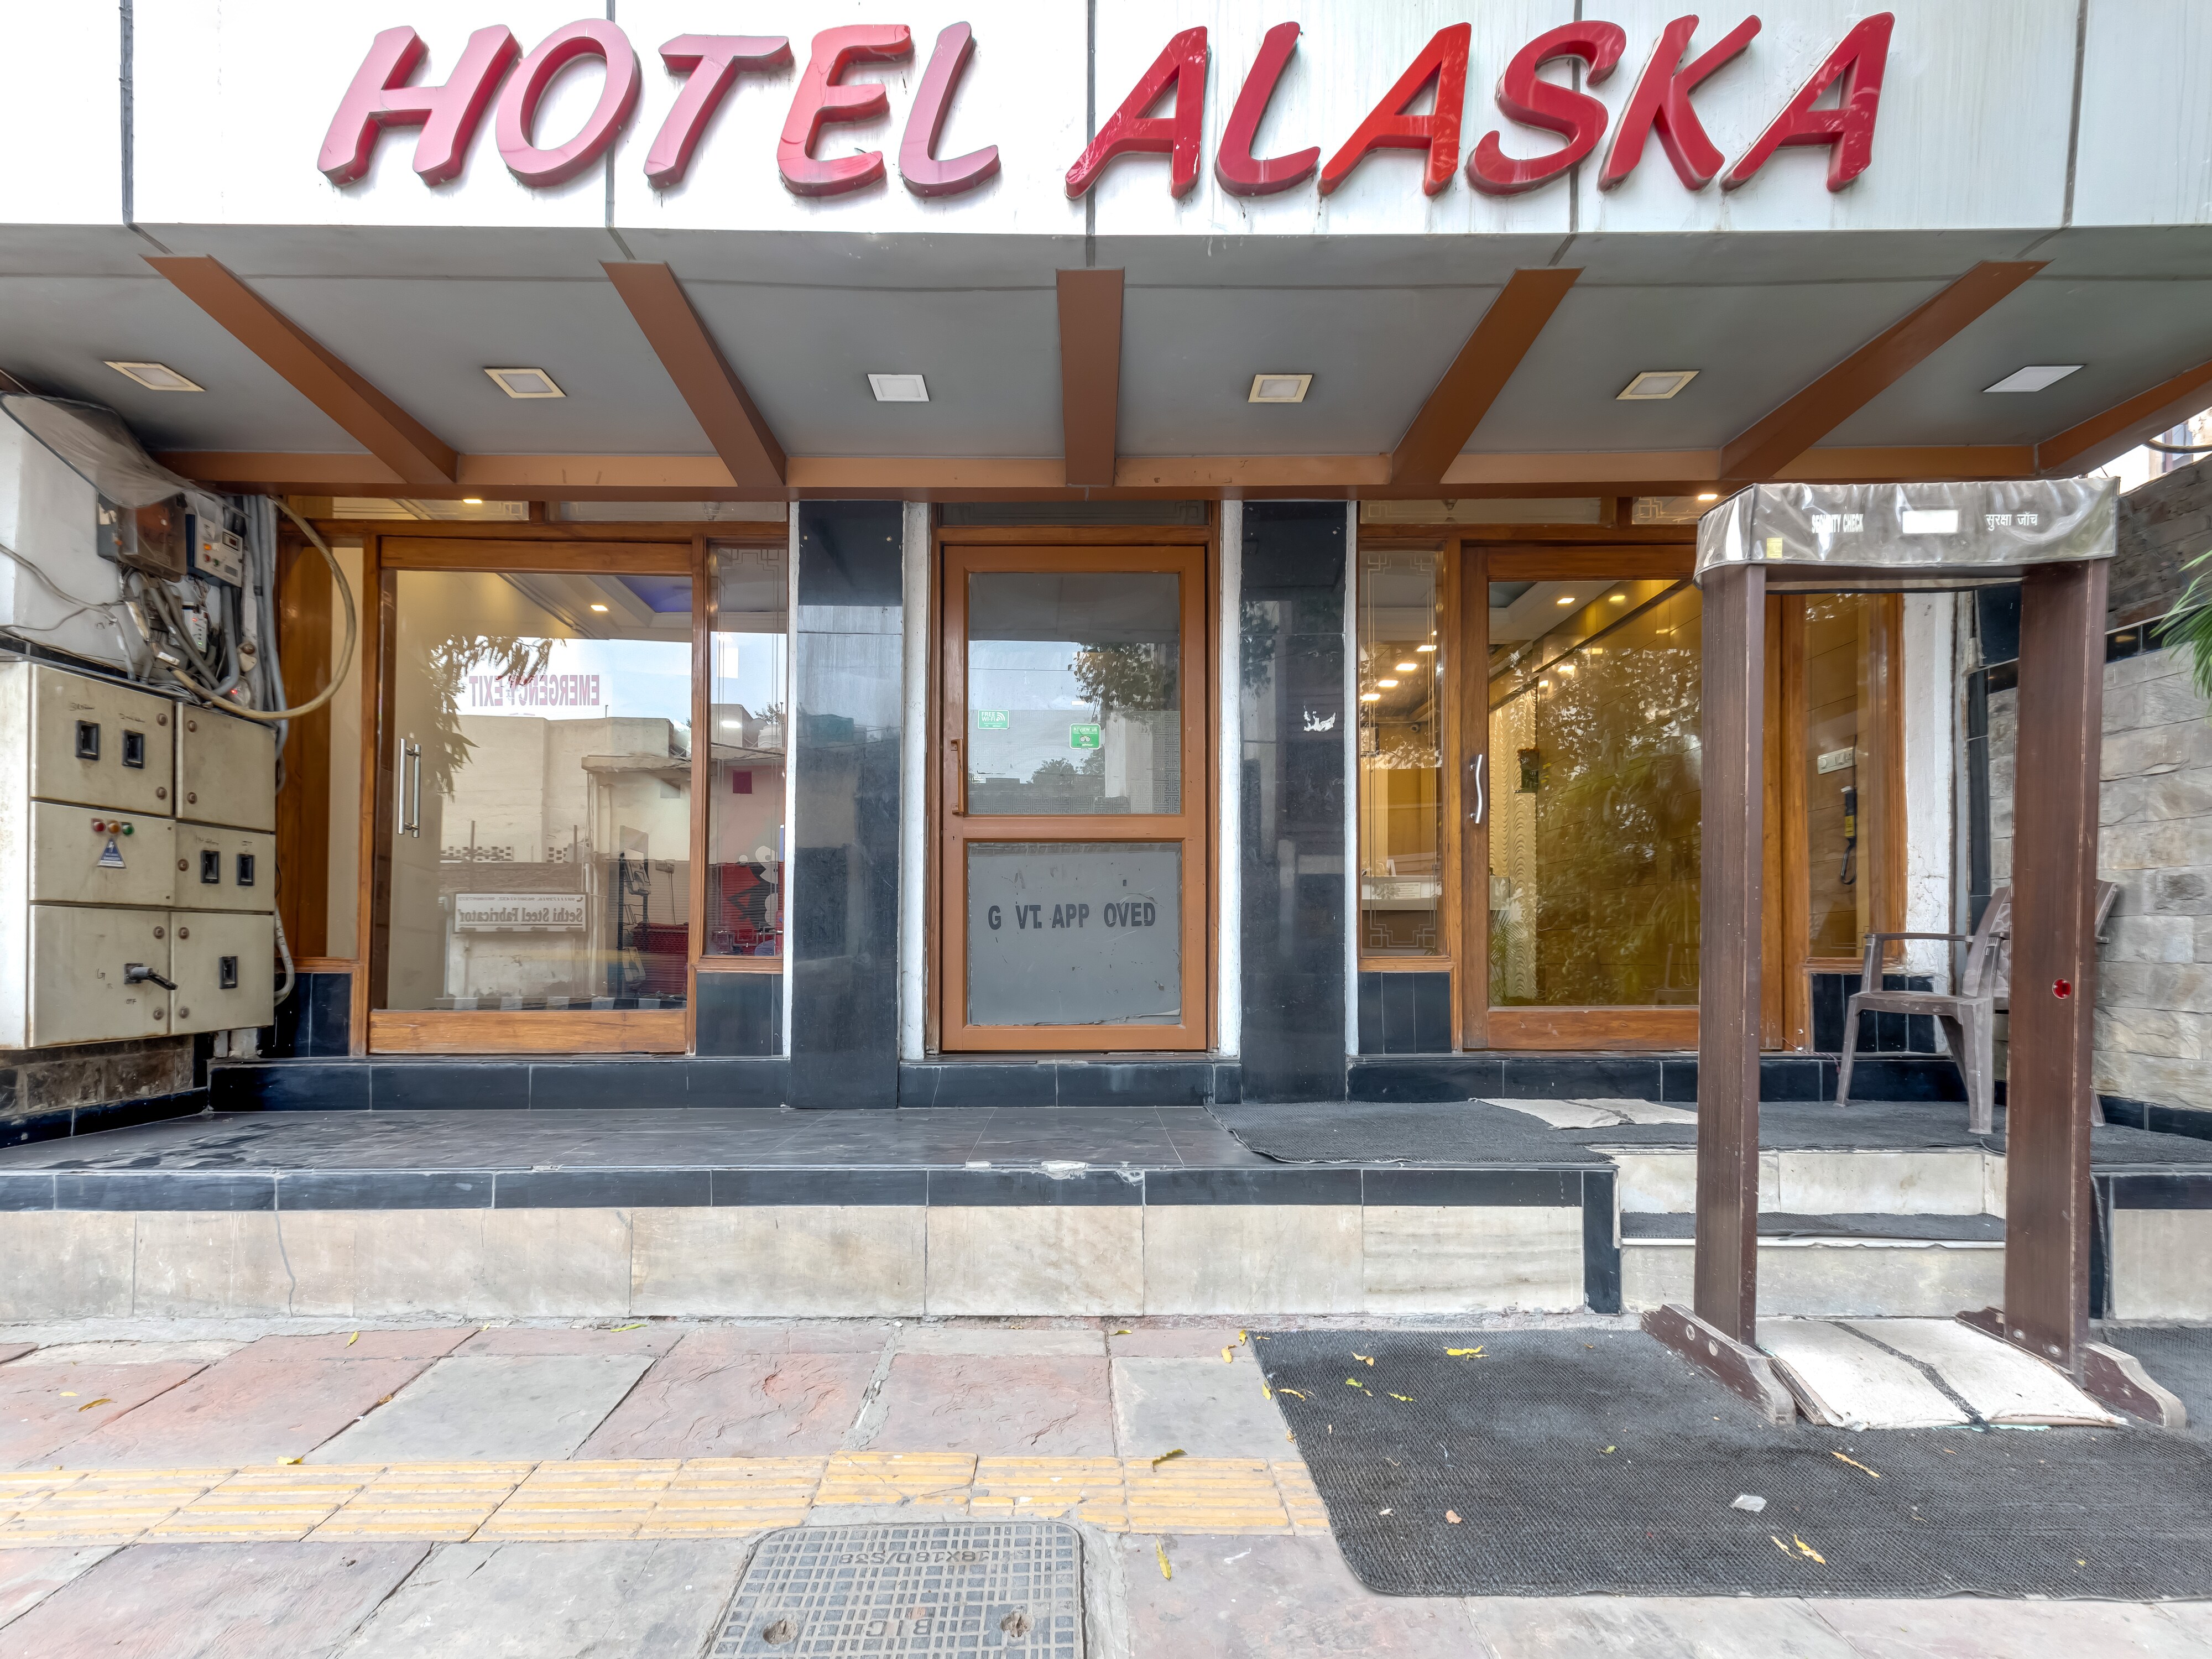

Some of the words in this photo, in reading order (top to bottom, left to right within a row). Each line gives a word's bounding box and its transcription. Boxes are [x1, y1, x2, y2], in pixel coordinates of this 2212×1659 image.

[317, 18, 1000, 196] HOTEL
[1065, 12, 1895, 200] ALASKA
[1843, 513, 1864, 533] CHECK
[1985, 514, 2012, 531] सुरक्षा
